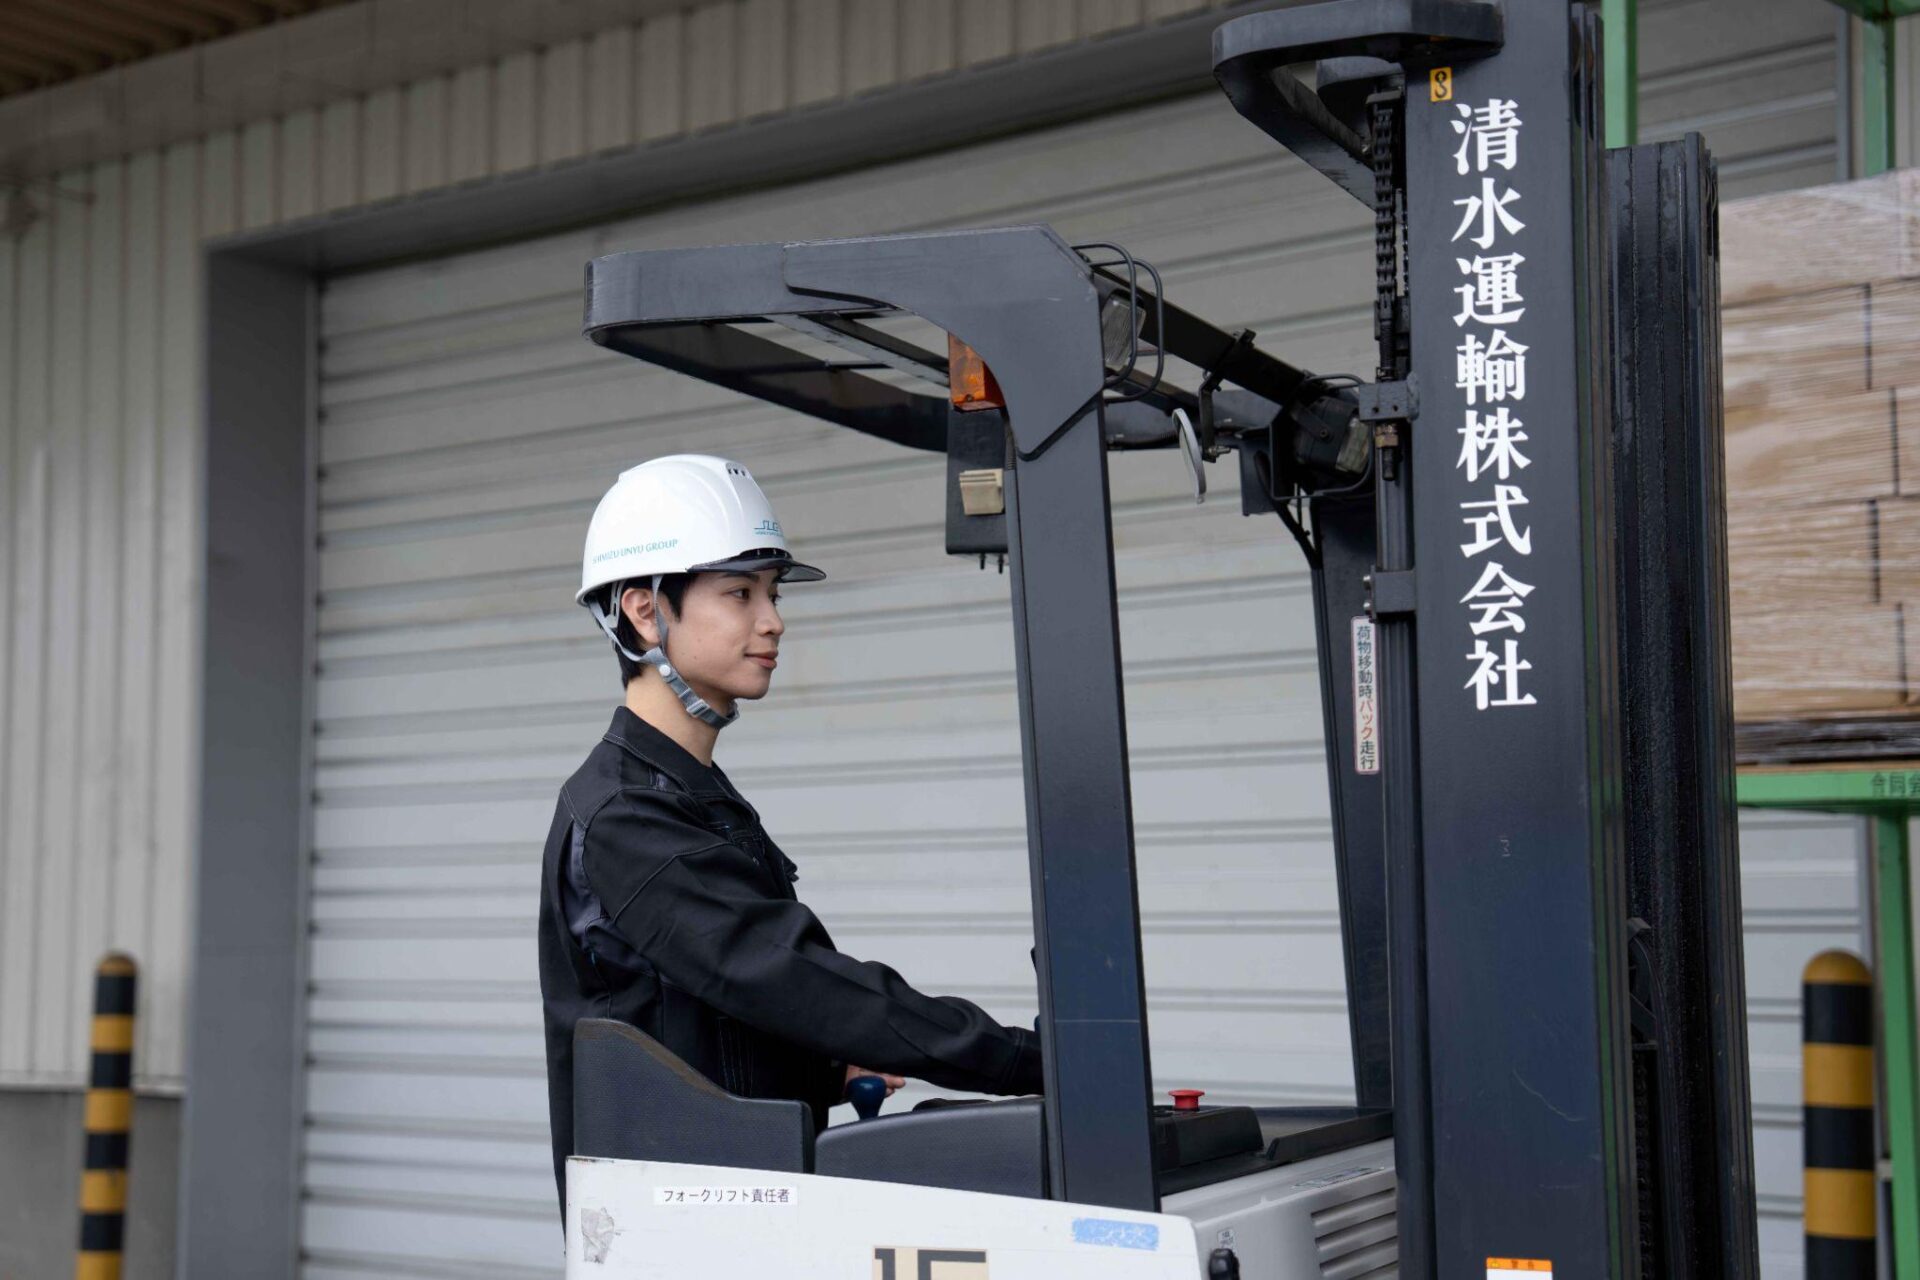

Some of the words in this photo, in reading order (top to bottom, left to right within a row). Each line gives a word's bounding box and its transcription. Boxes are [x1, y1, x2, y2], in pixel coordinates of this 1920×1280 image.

[1450, 98, 1537, 710] 清水運輸株式会社
[621, 544, 644, 557] UNYU
[646, 539, 678, 552] GROUP
[664, 1188, 790, 1203] フォークリフト責任者
